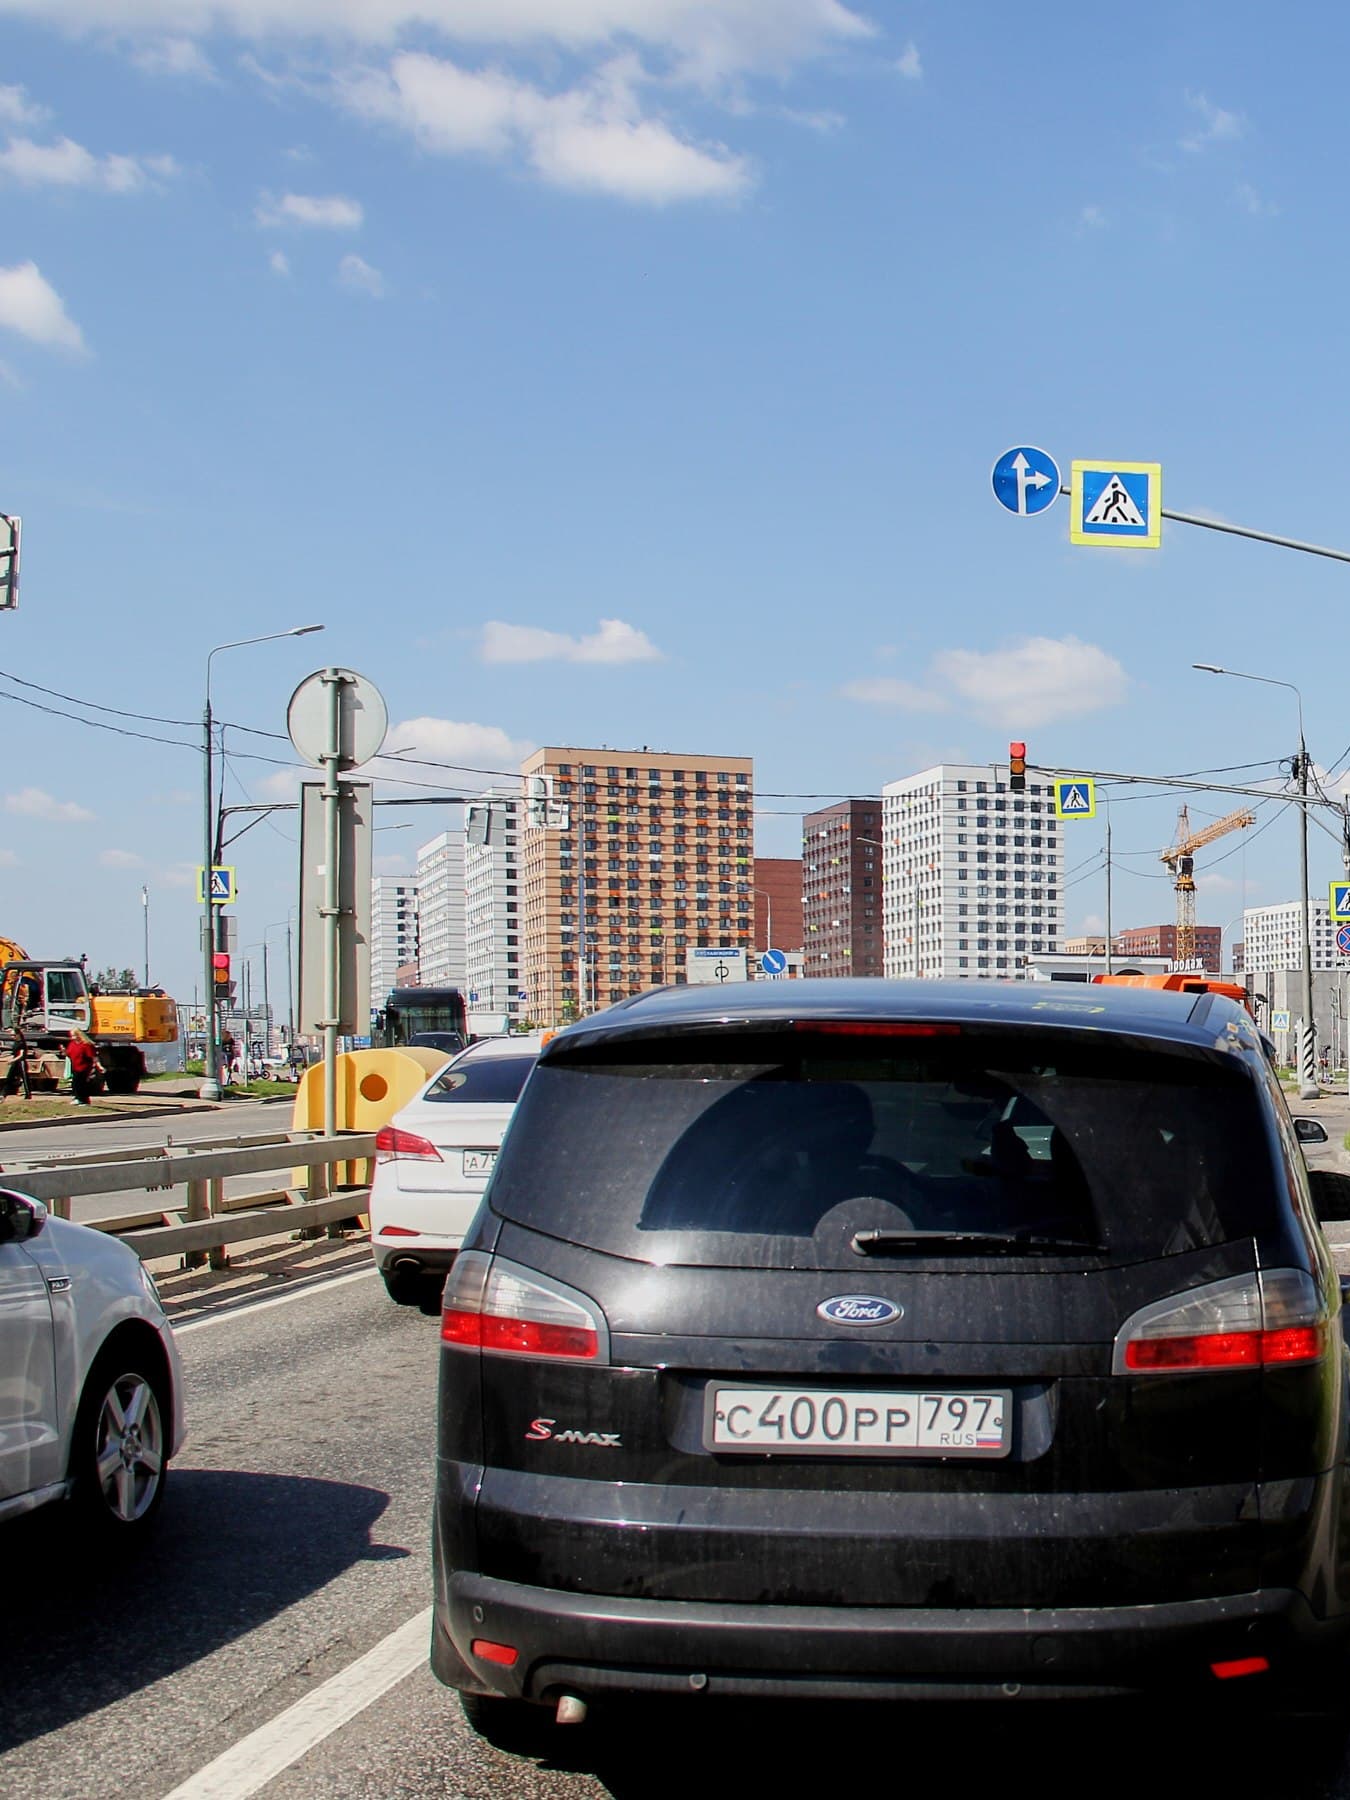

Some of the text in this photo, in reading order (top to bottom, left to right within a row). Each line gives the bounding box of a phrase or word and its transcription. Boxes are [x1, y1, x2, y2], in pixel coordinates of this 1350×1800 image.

[1168, 958, 1204, 972] продаж
[835, 1300, 881, 1319] Ford
[726, 1395, 993, 1443] С400РР 797
[940, 1432, 975, 1446] RUS
